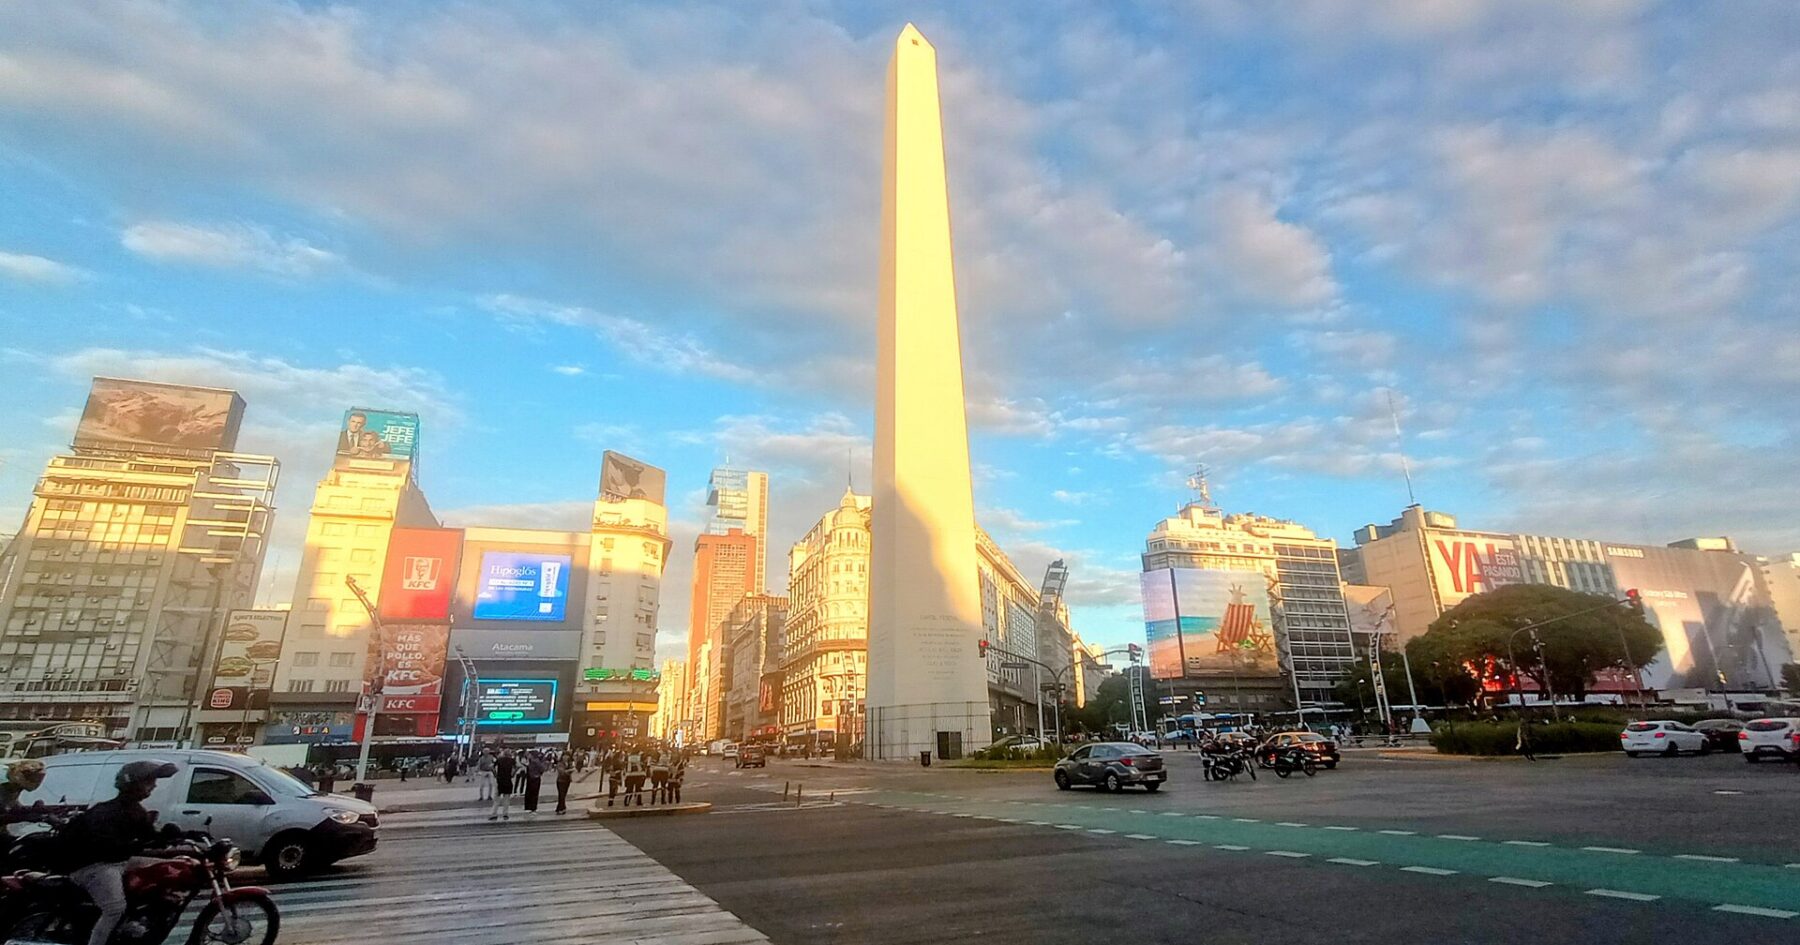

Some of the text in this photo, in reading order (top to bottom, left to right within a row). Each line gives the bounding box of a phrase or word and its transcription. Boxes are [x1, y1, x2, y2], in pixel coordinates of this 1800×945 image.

[383, 424, 416, 436] JEFE
[380, 433, 414, 444] JEFE
[1607, 546, 1644, 558] SAMSUNG
[1482, 565, 1520, 578] PASANDO
[407, 580, 431, 588] KFC
[396, 643, 419, 652] QUE
[492, 643, 534, 651] Atacama
[387, 670, 421, 681] KFC
[387, 700, 415, 709] KFC
